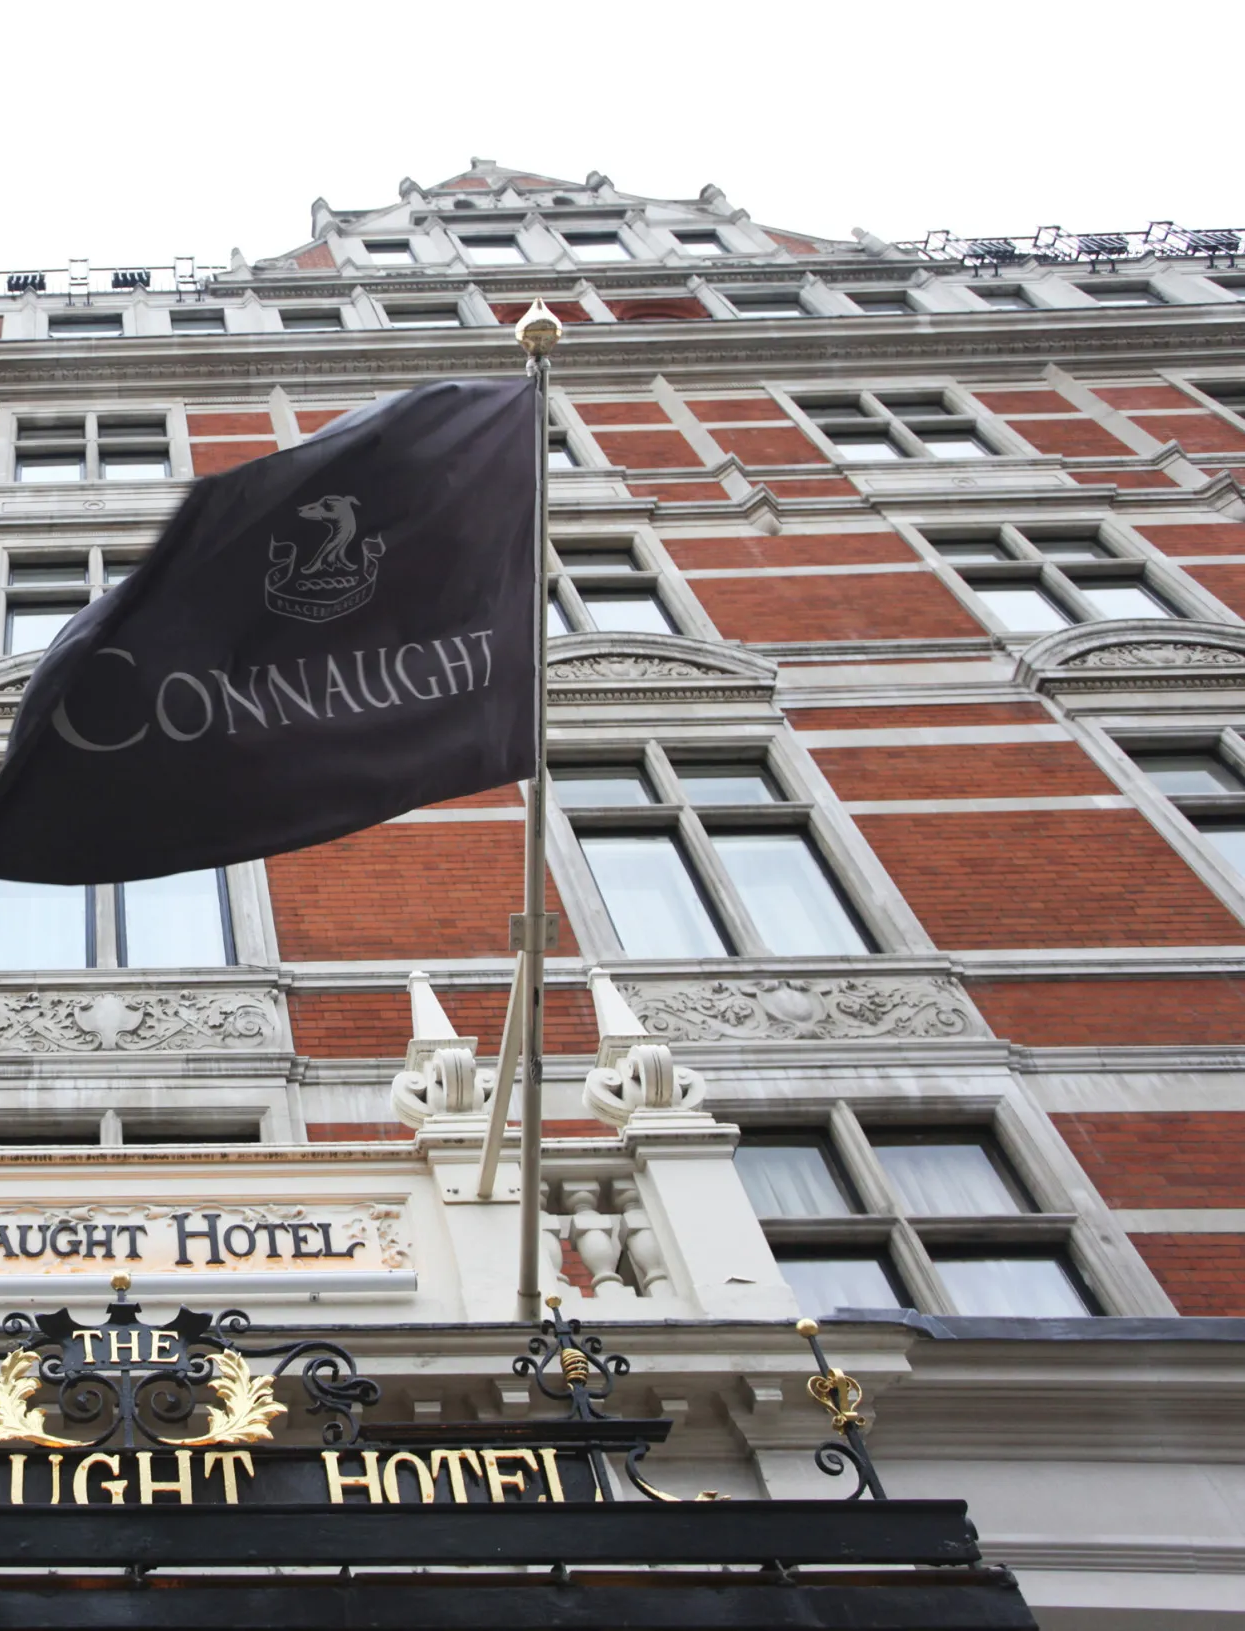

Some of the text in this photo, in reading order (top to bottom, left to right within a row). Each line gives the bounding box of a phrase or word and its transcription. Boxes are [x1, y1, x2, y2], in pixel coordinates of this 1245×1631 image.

[52, 629, 493, 752] CONNAUGHT
[171, 1212, 366, 1267] HOTEL
[72, 1330, 180, 1364] THE
[321, 1448, 604, 1504] HOTEL
